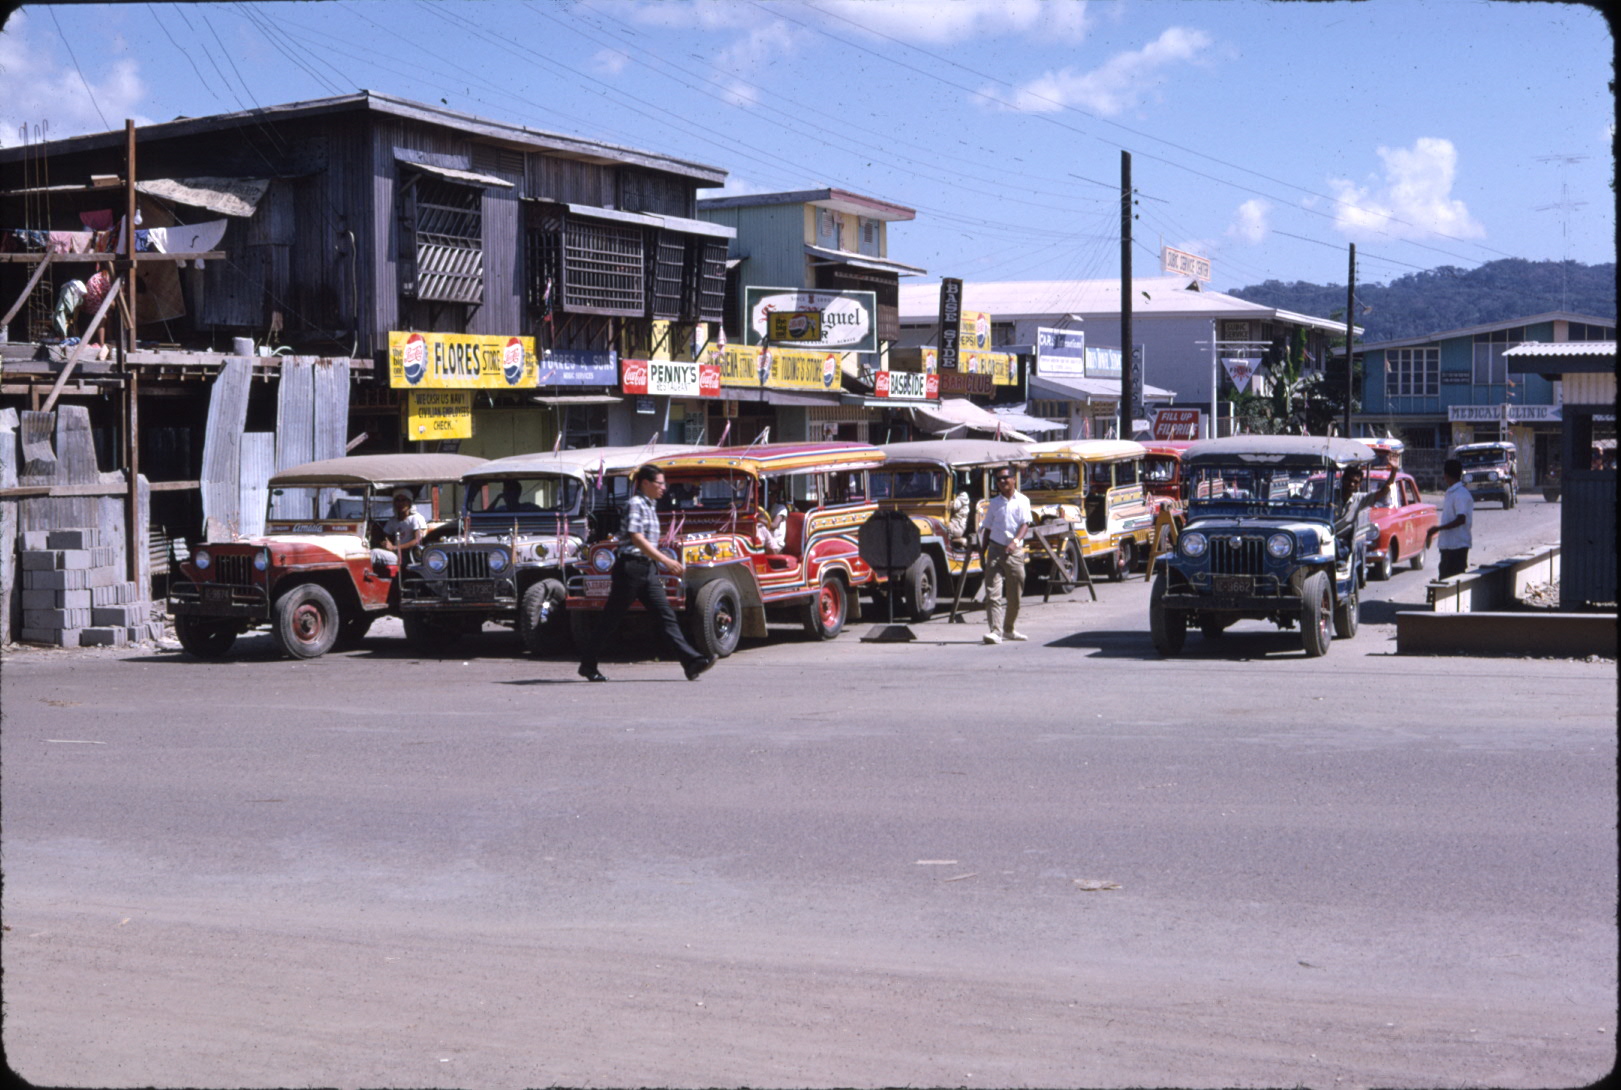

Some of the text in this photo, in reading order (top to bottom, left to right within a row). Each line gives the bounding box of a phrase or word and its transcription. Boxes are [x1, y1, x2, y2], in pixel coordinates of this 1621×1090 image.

[945, 283, 958, 322] BASE
[821, 308, 861, 329] iguel
[942, 330, 957, 368] SIDE
[434, 342, 501, 378] FLORES STORE
[542, 354, 576, 370] TORRES
[593, 355, 615, 371] SONS
[650, 364, 697, 384] PENNY'S
[656, 382, 691, 392] RESTAURANT
[965, 375, 993, 392] CLUB
[415, 393, 464, 405] WE CASH US NAVY
[418, 406, 441, 418] CIVILIAN
[1161, 412, 1192, 421] FILL UP
[1451, 406, 1547, 419] MEDICAL CLINIC
[1156, 423, 1199, 436] FILPRIDE
